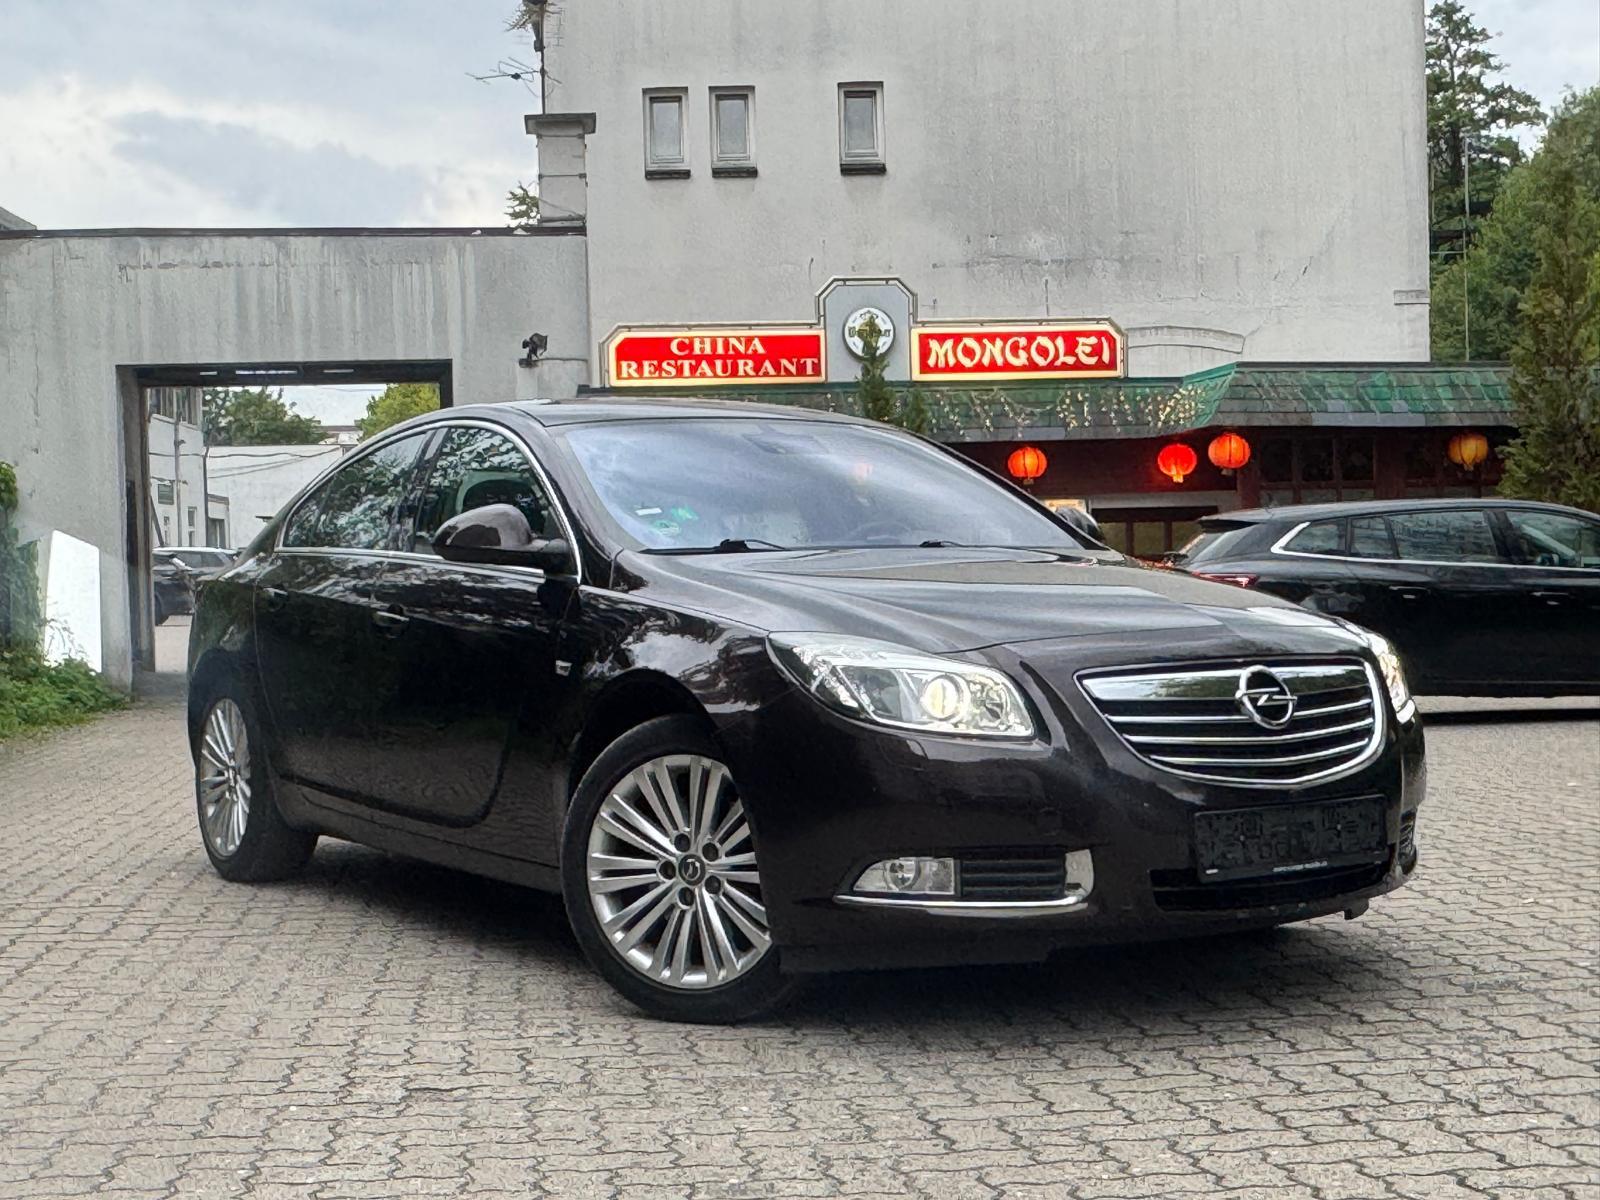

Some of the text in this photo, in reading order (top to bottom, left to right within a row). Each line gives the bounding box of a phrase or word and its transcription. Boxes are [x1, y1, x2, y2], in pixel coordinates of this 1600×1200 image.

[670, 337, 767, 356] CHINA
[926, 335, 1110, 368] MONGOLEI
[619, 357, 819, 378] RESTAURANT
